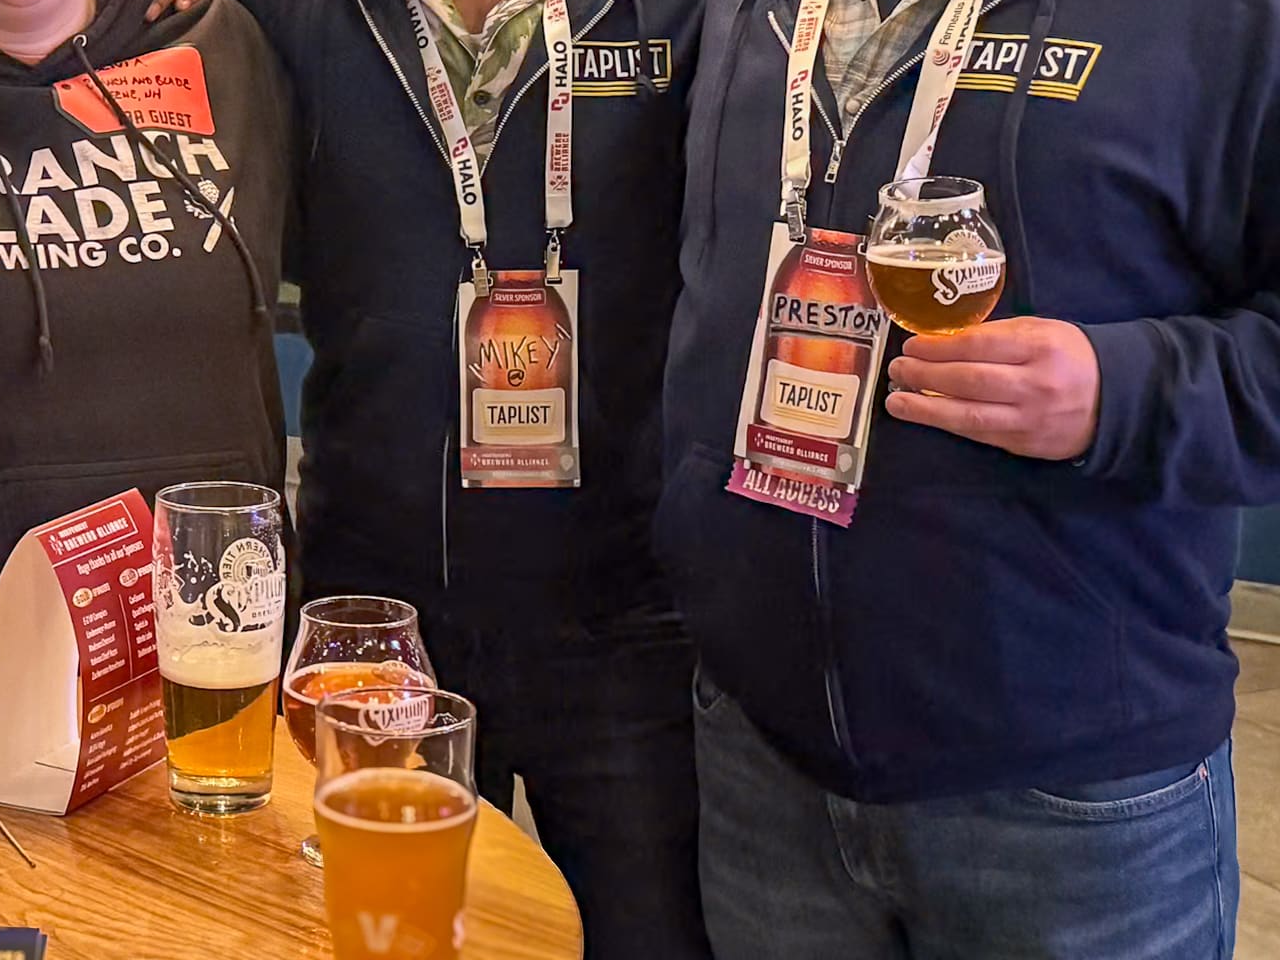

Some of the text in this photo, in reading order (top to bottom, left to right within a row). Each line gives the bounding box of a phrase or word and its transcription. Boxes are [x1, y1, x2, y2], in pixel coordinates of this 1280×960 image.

[409, 5, 429, 48] HALO
[553, 41, 568, 87] HALO
[149, 109, 192, 128] GUEST
[792, 91, 805, 141] HALO
[457, 157, 477, 205] HALO
[119, 234, 182, 263] CO.
[804, 253, 853, 271] SILVER SPONSOR
[494, 292, 542, 304] SILVER SPONSOR
[774, 296, 881, 332] PRESTON
[478, 336, 560, 370] MIKEY
[487, 405, 551, 425] TAPLIST
[778, 382, 842, 415] TAPLIST
[742, 470, 841, 513] ALL ACCESS
